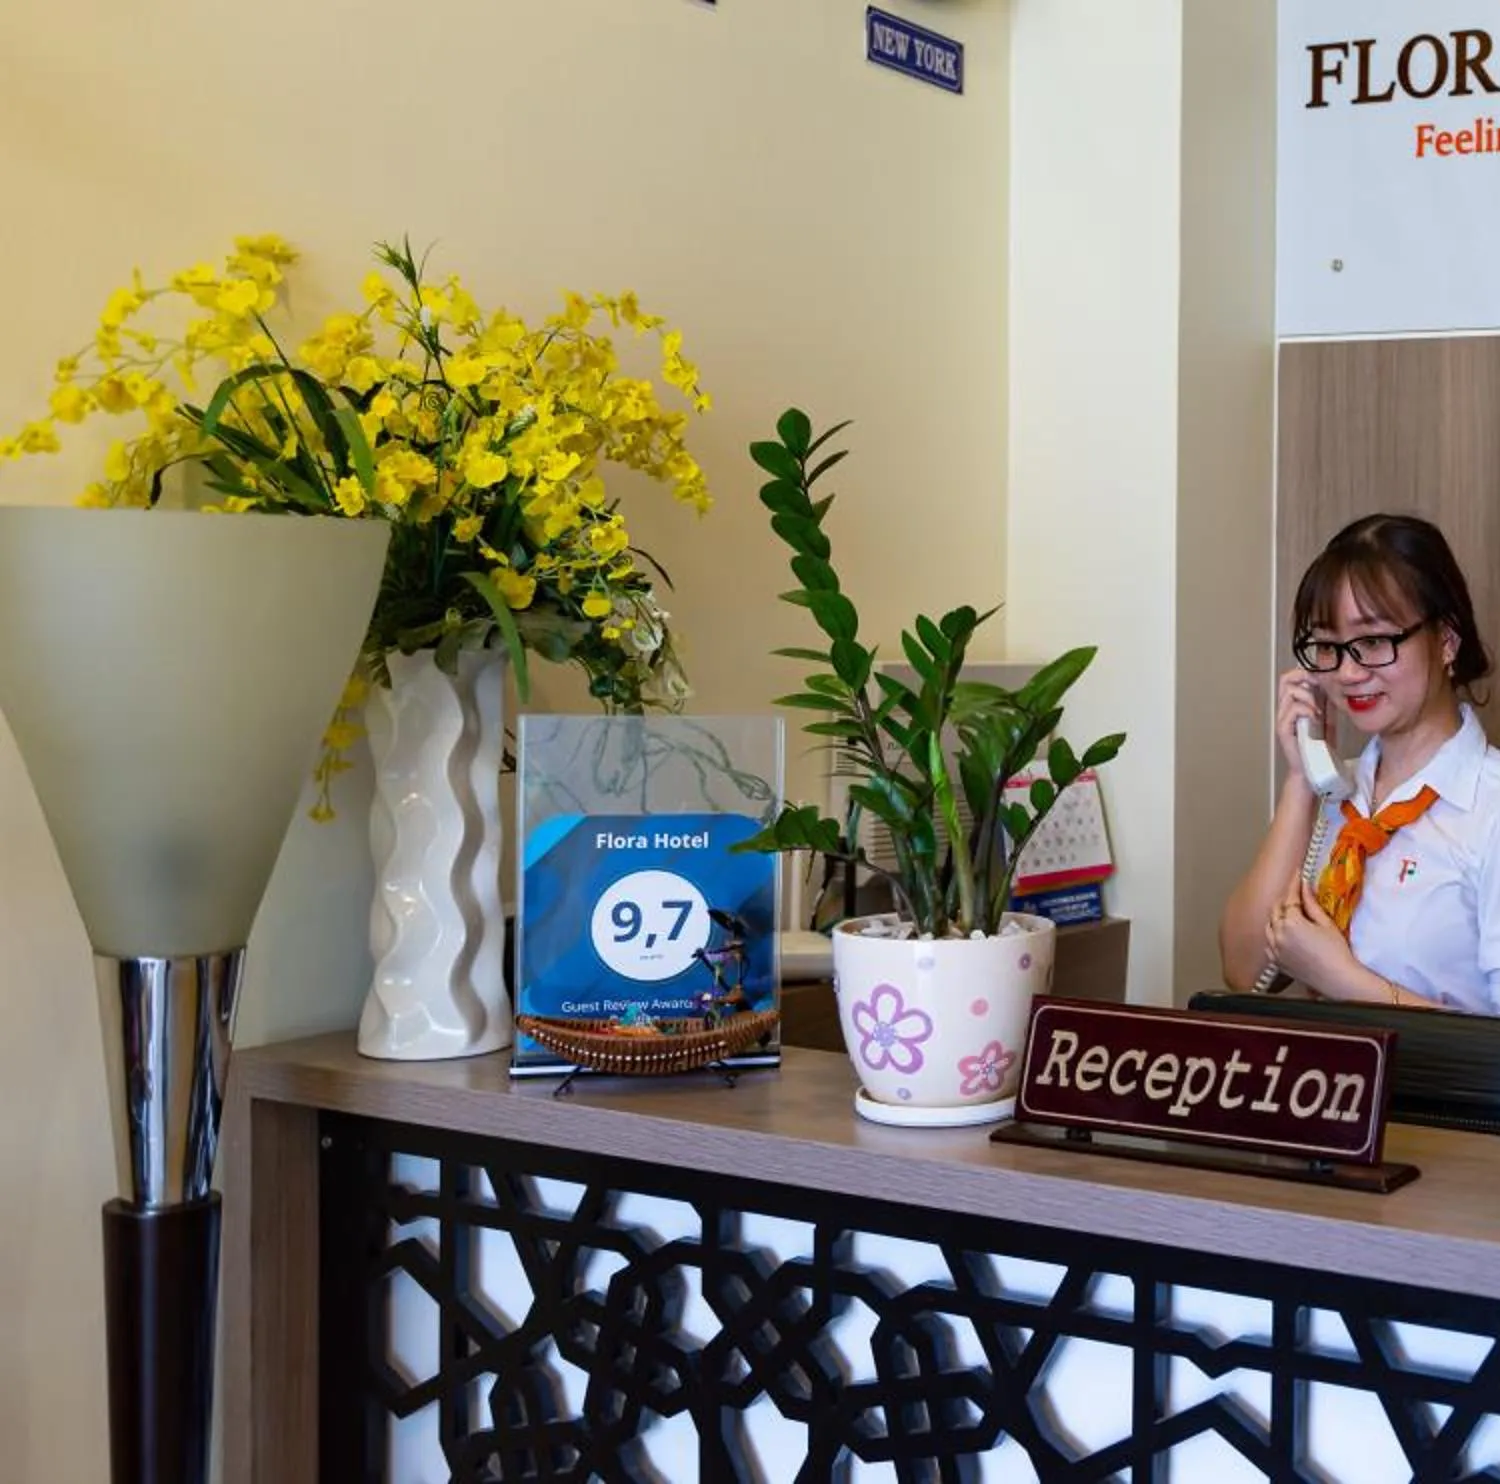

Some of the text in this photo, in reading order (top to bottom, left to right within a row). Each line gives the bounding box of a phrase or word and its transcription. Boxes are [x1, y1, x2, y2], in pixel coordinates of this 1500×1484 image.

[873, 21, 957, 81] NEW YORK
[596, 831, 709, 849] Flora Hotel
[611, 900, 693, 948] 9,7
[561, 1001, 600, 1013] Guest
[1036, 1029, 1366, 1123] Reception
